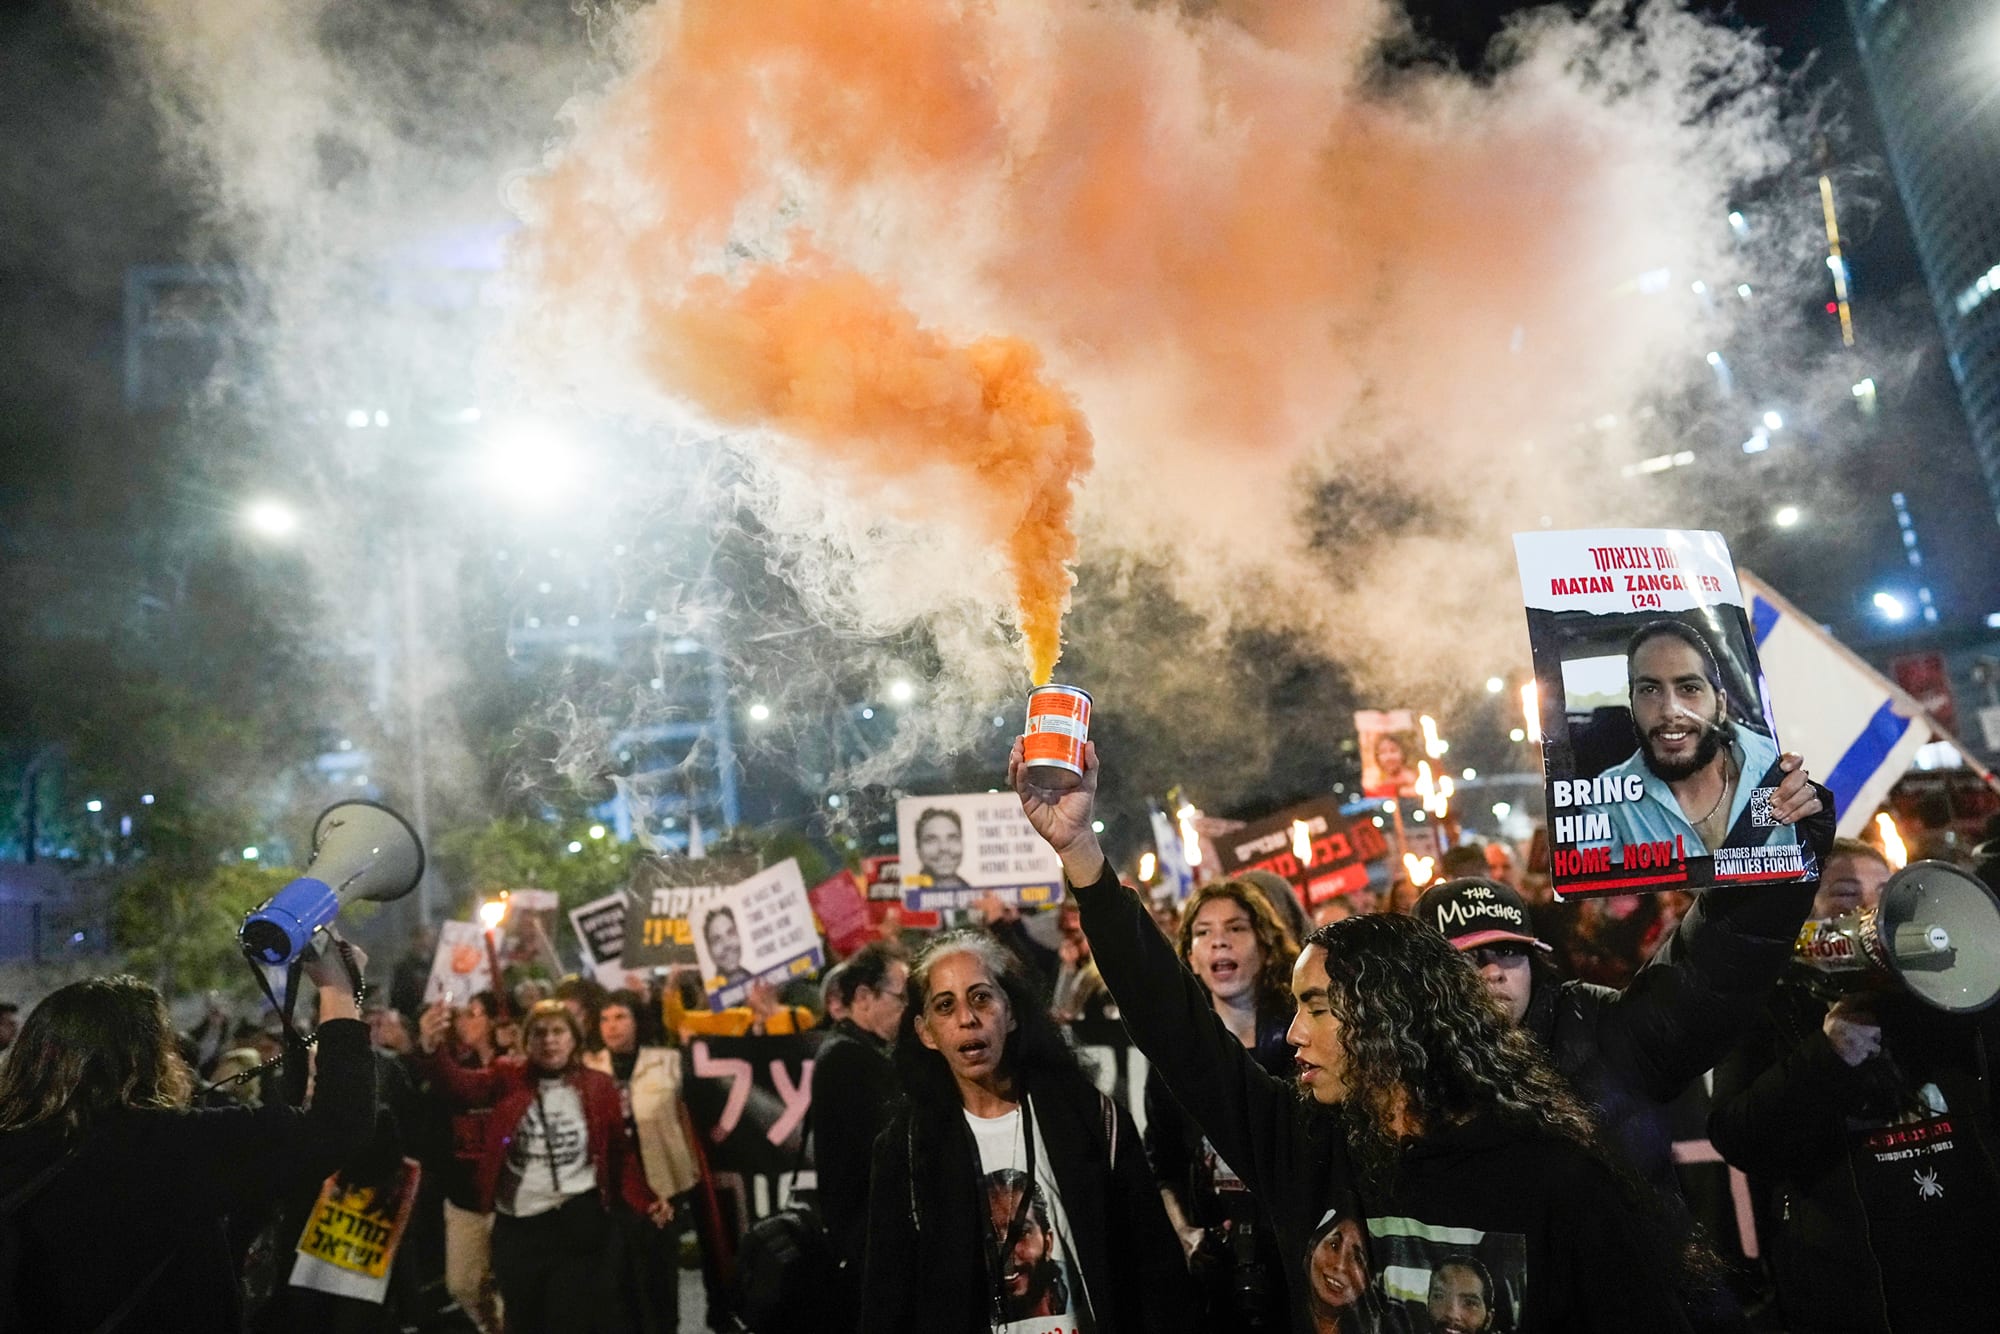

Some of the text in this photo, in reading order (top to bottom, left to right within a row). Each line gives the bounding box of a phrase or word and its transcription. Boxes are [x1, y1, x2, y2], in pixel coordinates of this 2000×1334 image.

[1588, 547, 1651, 572] צנגאוקר
[1551, 576, 1614, 595] MATAN
[1632, 593, 1661, 608] (24)
[1553, 774, 1644, 807] BRING
[1555, 813, 1612, 843] HIM
[1554, 834, 1687, 877] HOME NOW!
[1713, 844, 1801, 860] HOSTAGES AND MISSING
[1714, 855, 1803, 876] FAMILIES FORUM
